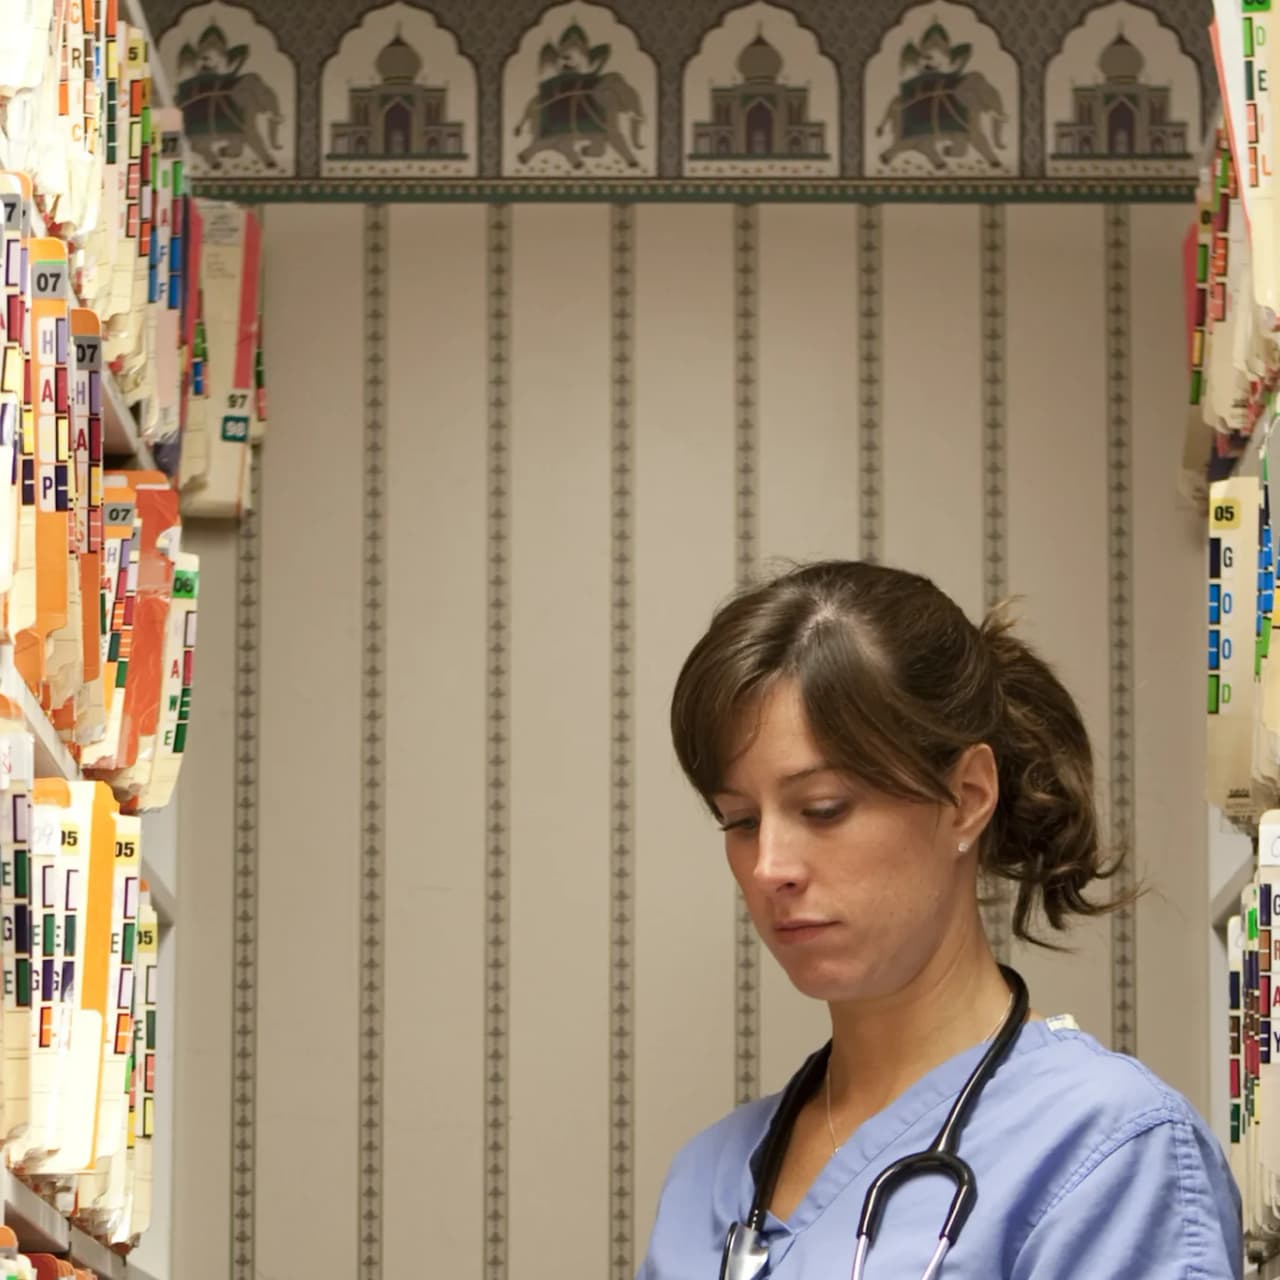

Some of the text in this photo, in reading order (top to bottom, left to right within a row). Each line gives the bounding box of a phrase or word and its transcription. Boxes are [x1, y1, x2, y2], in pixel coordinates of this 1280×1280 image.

[36, 273, 61, 292] 07
[76, 343, 98, 363] 07
[108, 508, 131, 521] 07
[1214, 506, 1235, 522] 05
[173, 577, 194, 593] 06
[115, 842, 135, 858] 05
